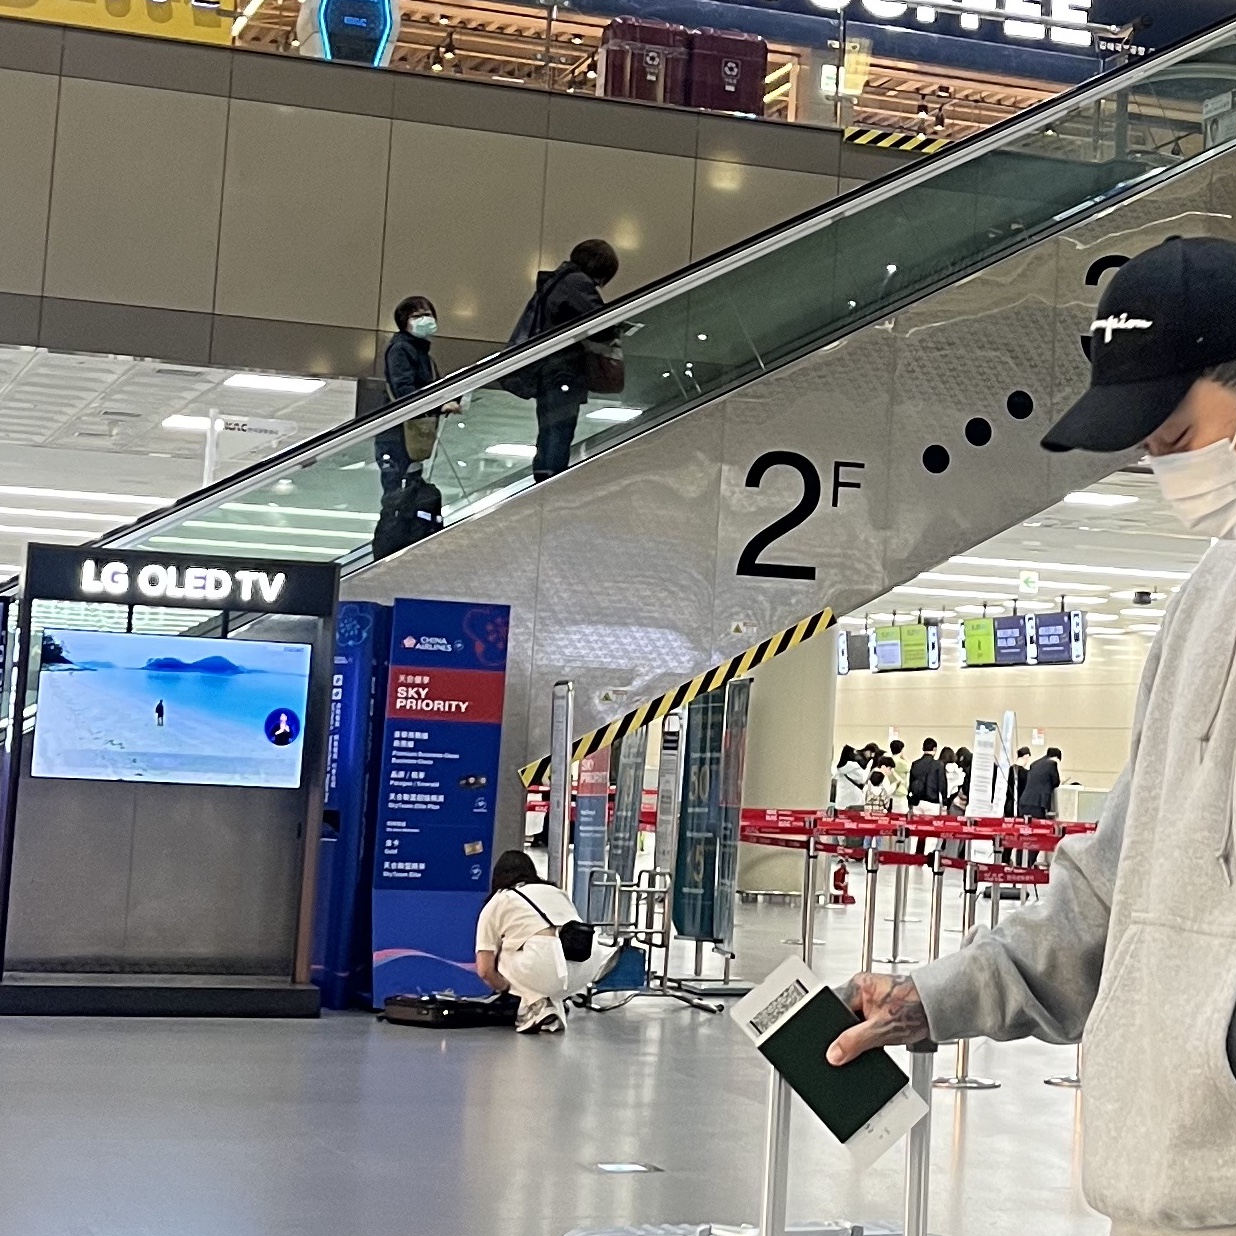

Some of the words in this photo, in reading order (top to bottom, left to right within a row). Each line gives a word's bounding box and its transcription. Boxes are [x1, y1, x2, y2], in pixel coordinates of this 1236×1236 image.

[81, 559, 129, 593] LG
[138, 564, 233, 599] OLED
[235, 570, 286, 602] TV
[397, 687, 429, 699] SKY
[396, 698, 469, 713] PRIORITY
